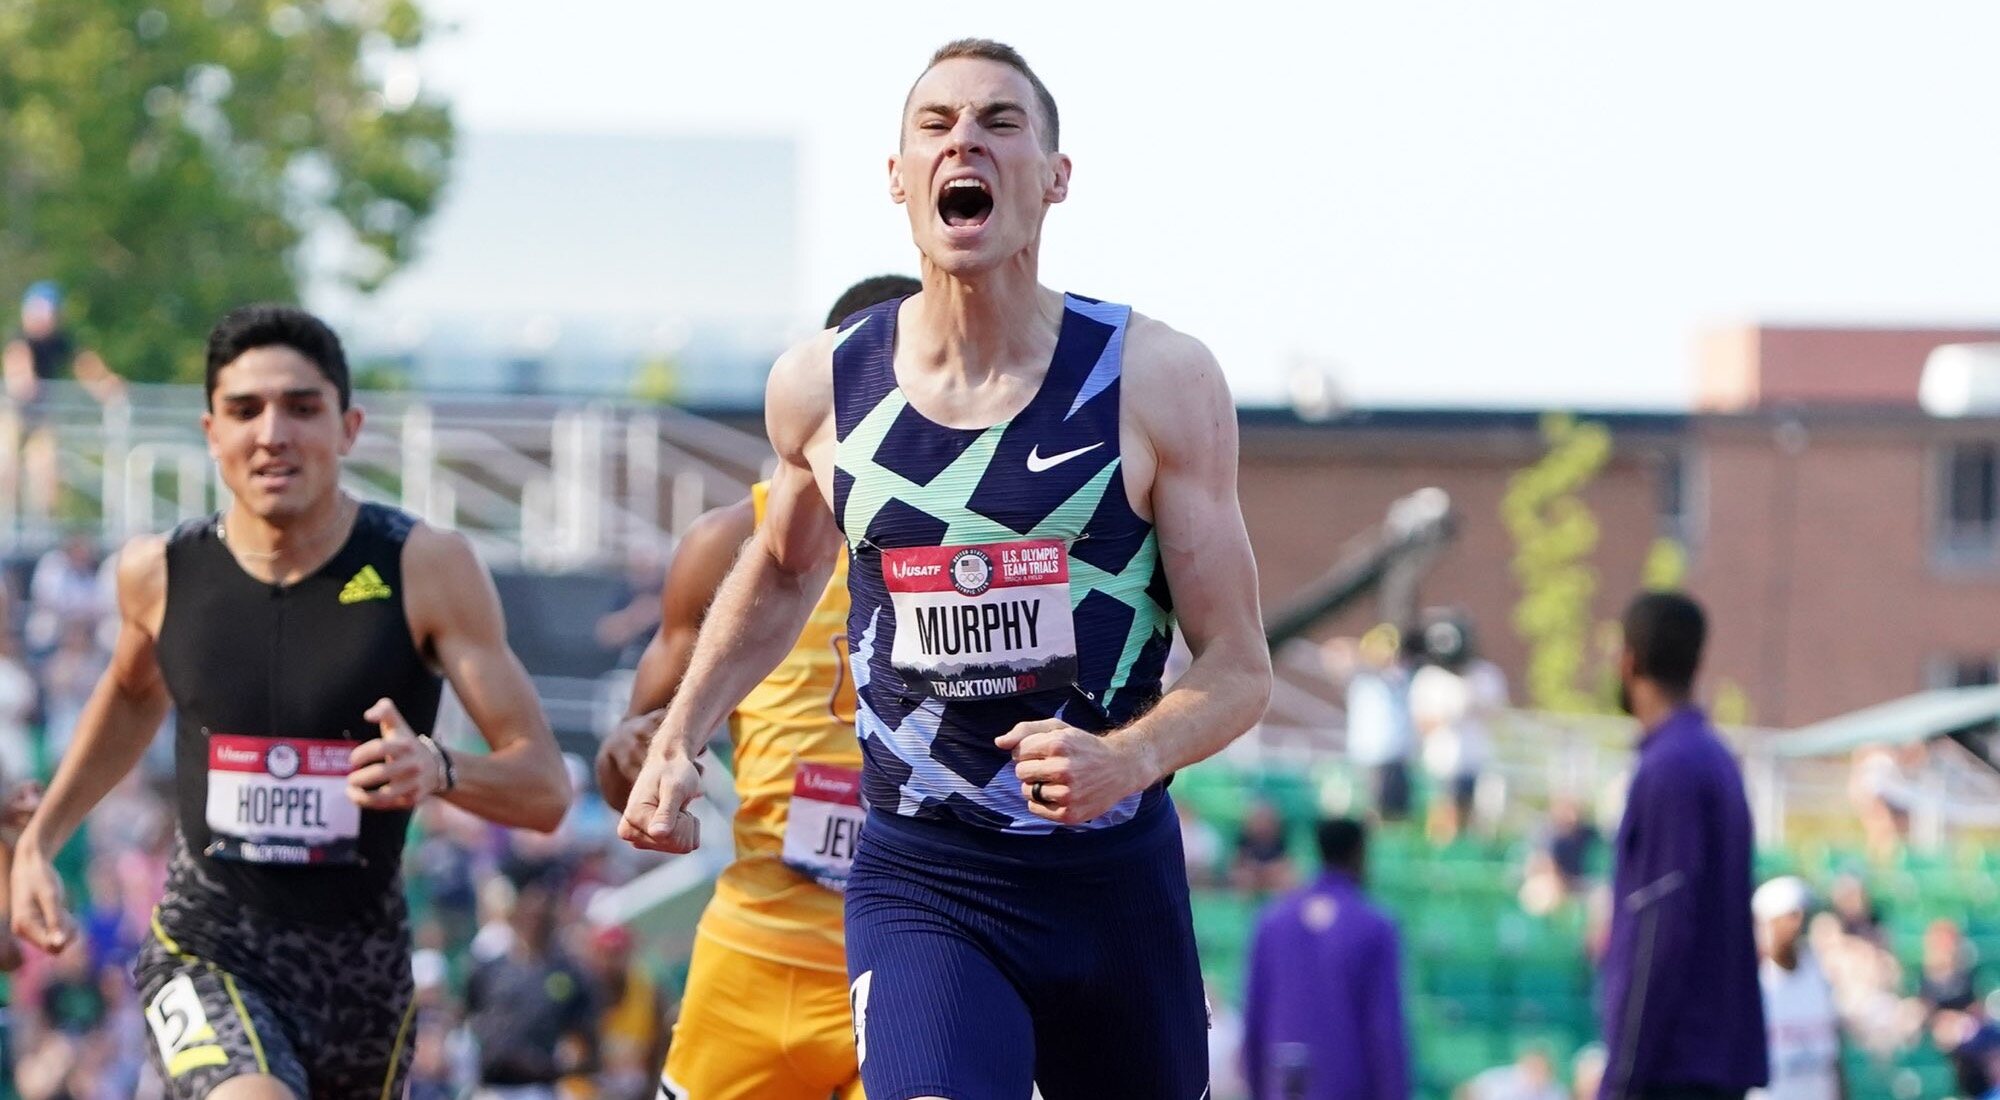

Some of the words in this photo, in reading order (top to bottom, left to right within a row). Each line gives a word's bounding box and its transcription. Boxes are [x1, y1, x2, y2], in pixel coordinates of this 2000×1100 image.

[1002, 549, 1020, 563] U.S.
[1021, 547, 1059, 562] OLYMPIC
[906, 565, 942, 577] USATF
[1003, 562, 1027, 576] TEAM
[1029, 560, 1059, 575] TRIALS
[915, 599, 1040, 655] MURPHY
[237, 786, 326, 828] HOPPEL
